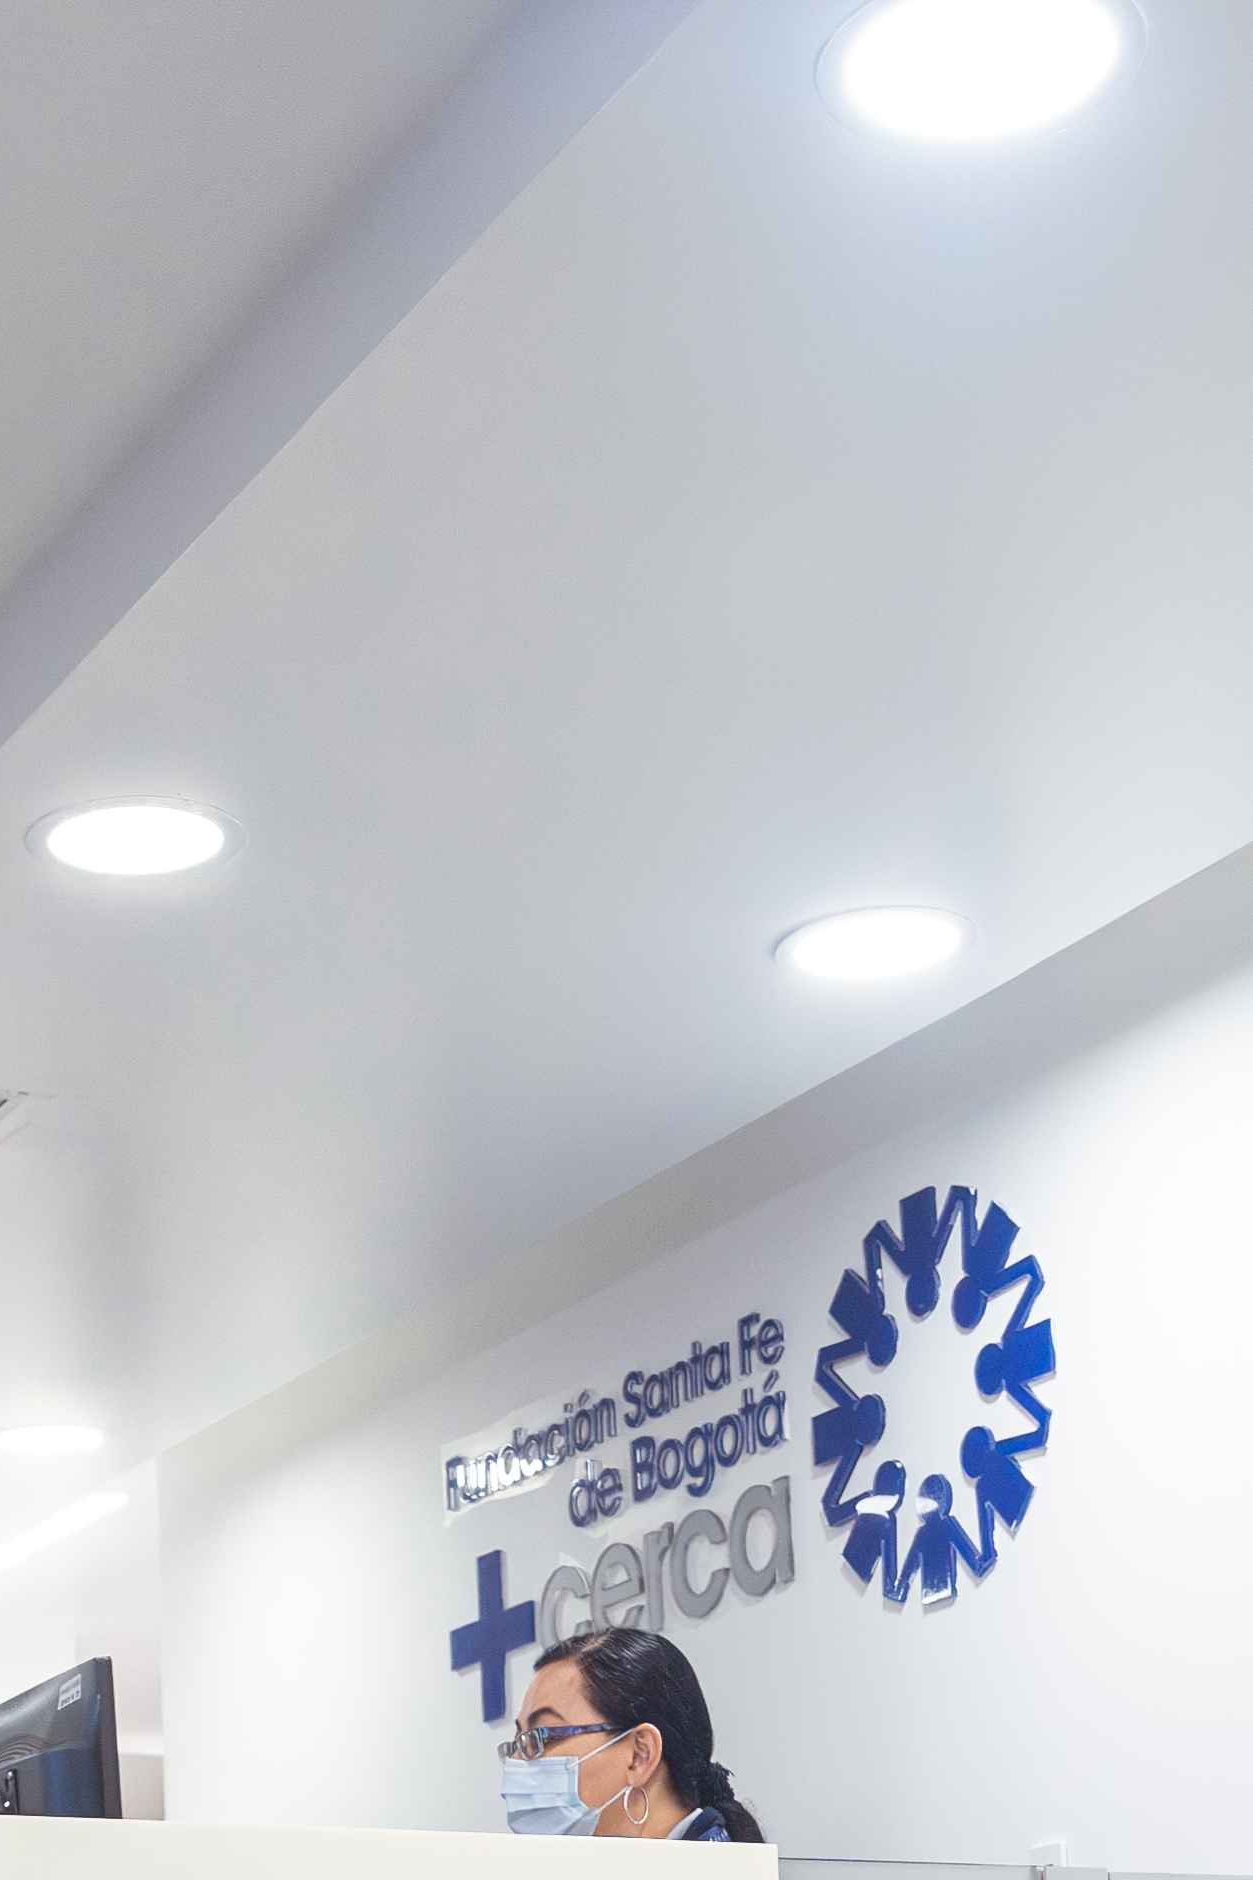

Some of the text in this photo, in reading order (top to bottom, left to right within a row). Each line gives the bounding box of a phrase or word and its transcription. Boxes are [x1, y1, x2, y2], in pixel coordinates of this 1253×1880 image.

[445, 1312, 784, 1512] Fundación Santa Fe
[569, 1369, 786, 1527] de Bogotá
